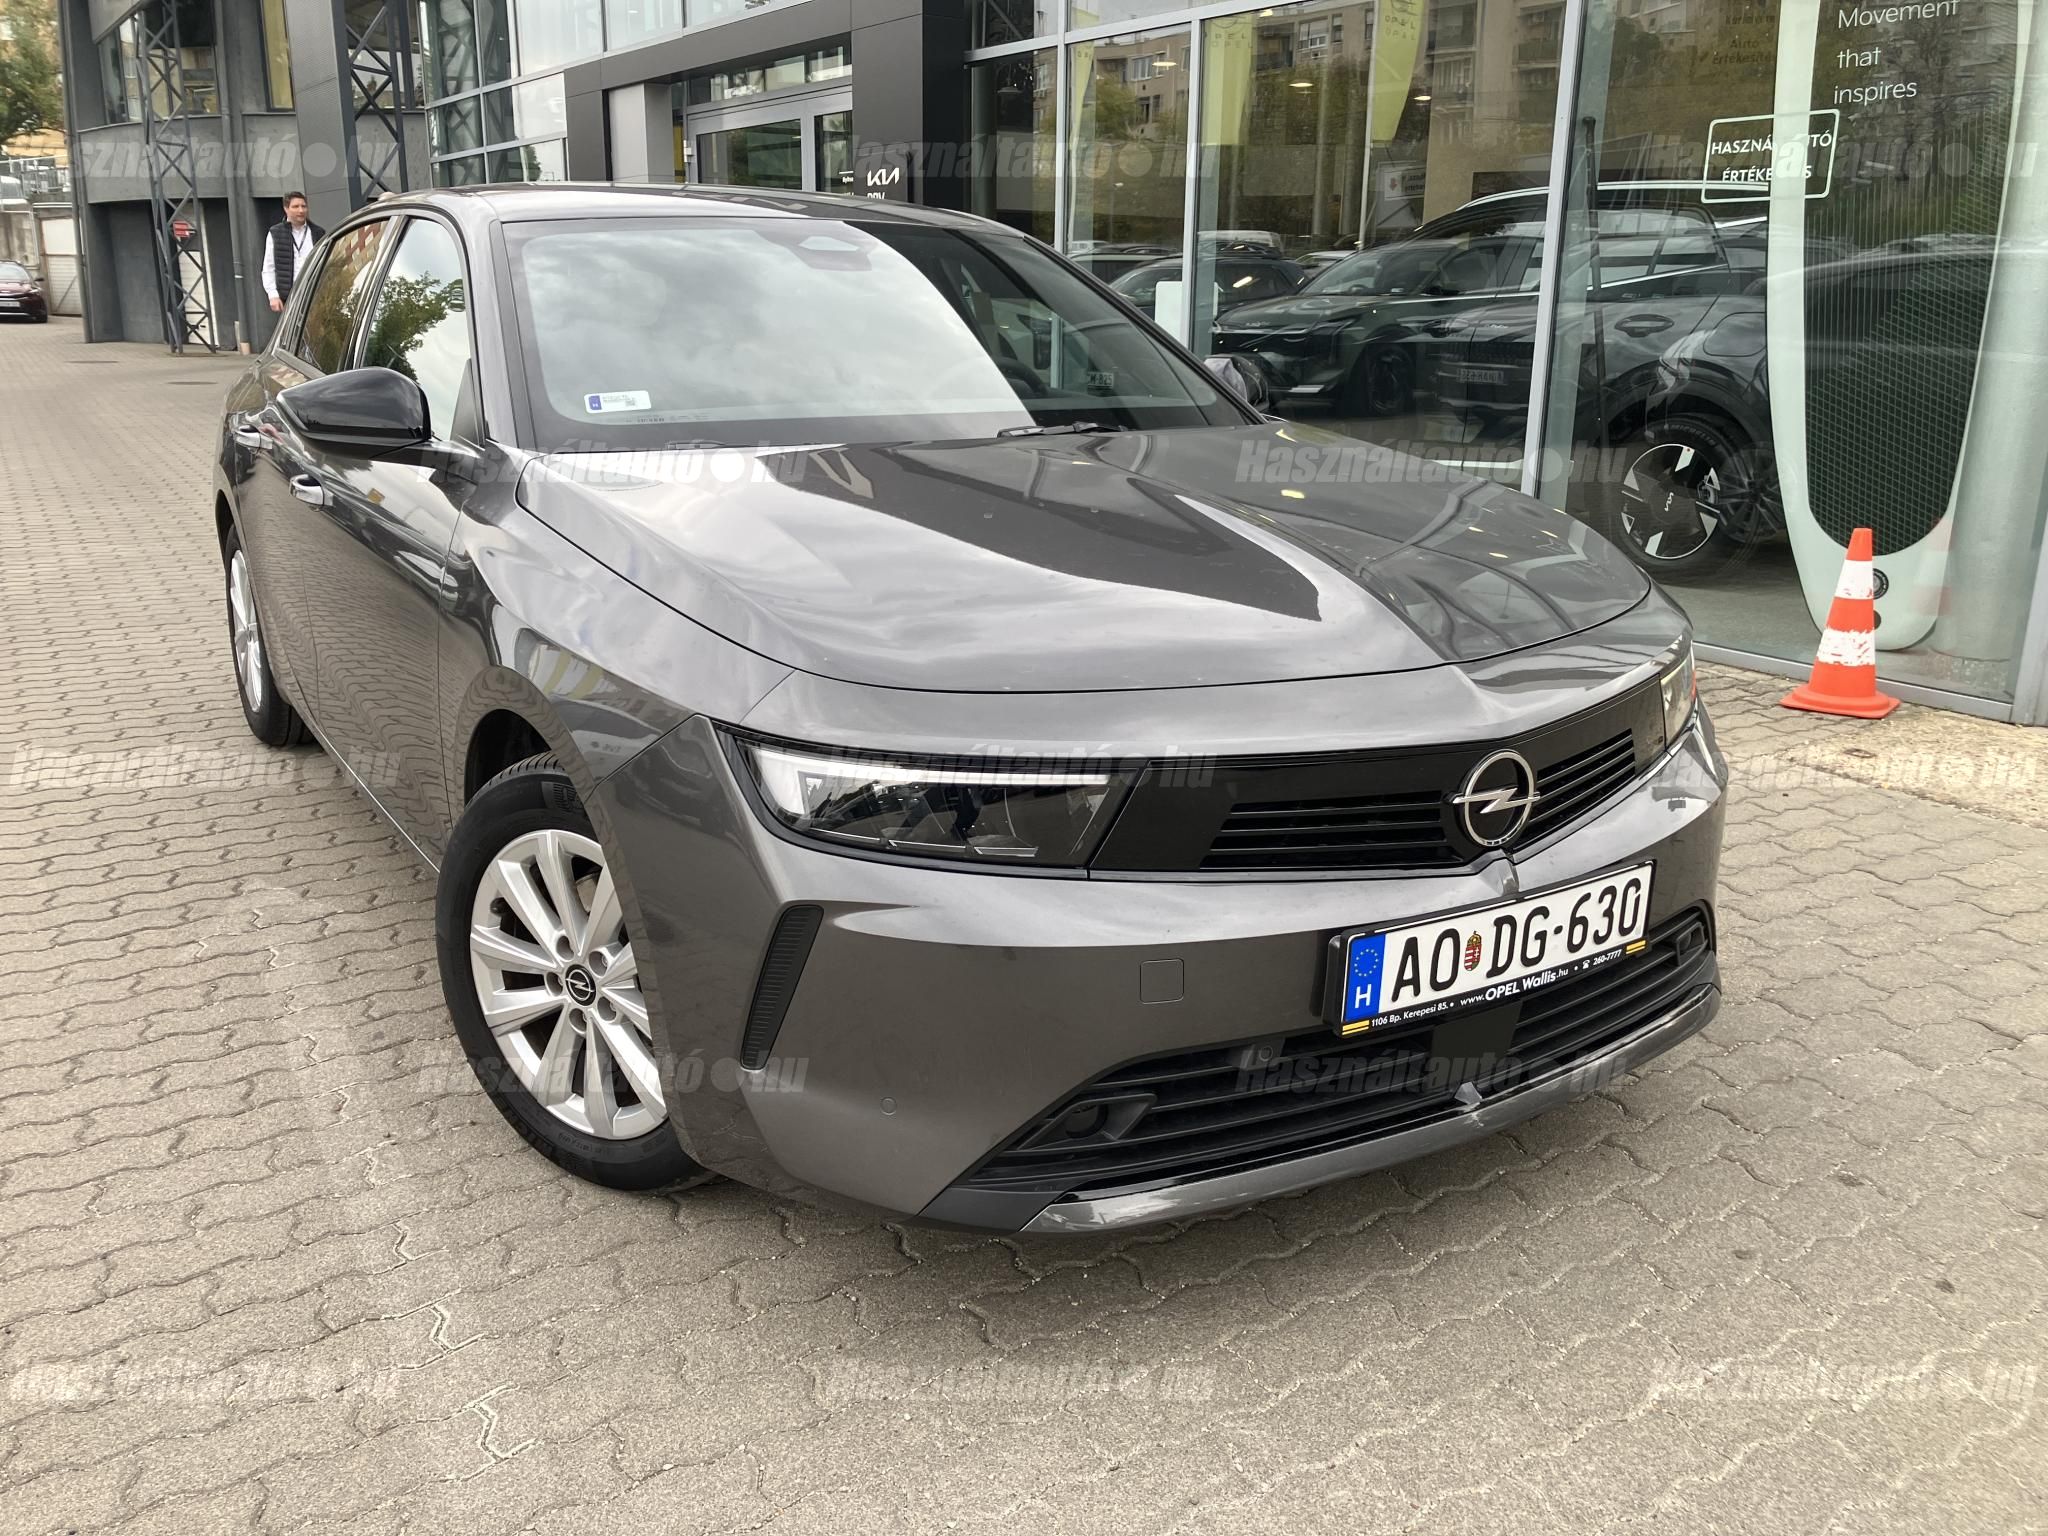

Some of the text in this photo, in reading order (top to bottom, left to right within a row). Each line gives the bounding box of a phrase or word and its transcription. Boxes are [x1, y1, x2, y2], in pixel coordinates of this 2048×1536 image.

[1838, 0, 1959, 29] Movement
[1836, 46, 1881, 69] that
[1833, 80, 1918, 107] inspires
[866, 167, 900, 187] KIA
[1391, 877, 1643, 1003] AO DG-630
[1355, 983, 1373, 1010] H
[1371, 1016, 1388, 1028] 1106
[1389, 1013, 1402, 1024] Bp.
[1403, 1003, 1437, 1021] Kerepesi
[1437, 1001, 1449, 1012] 85.
